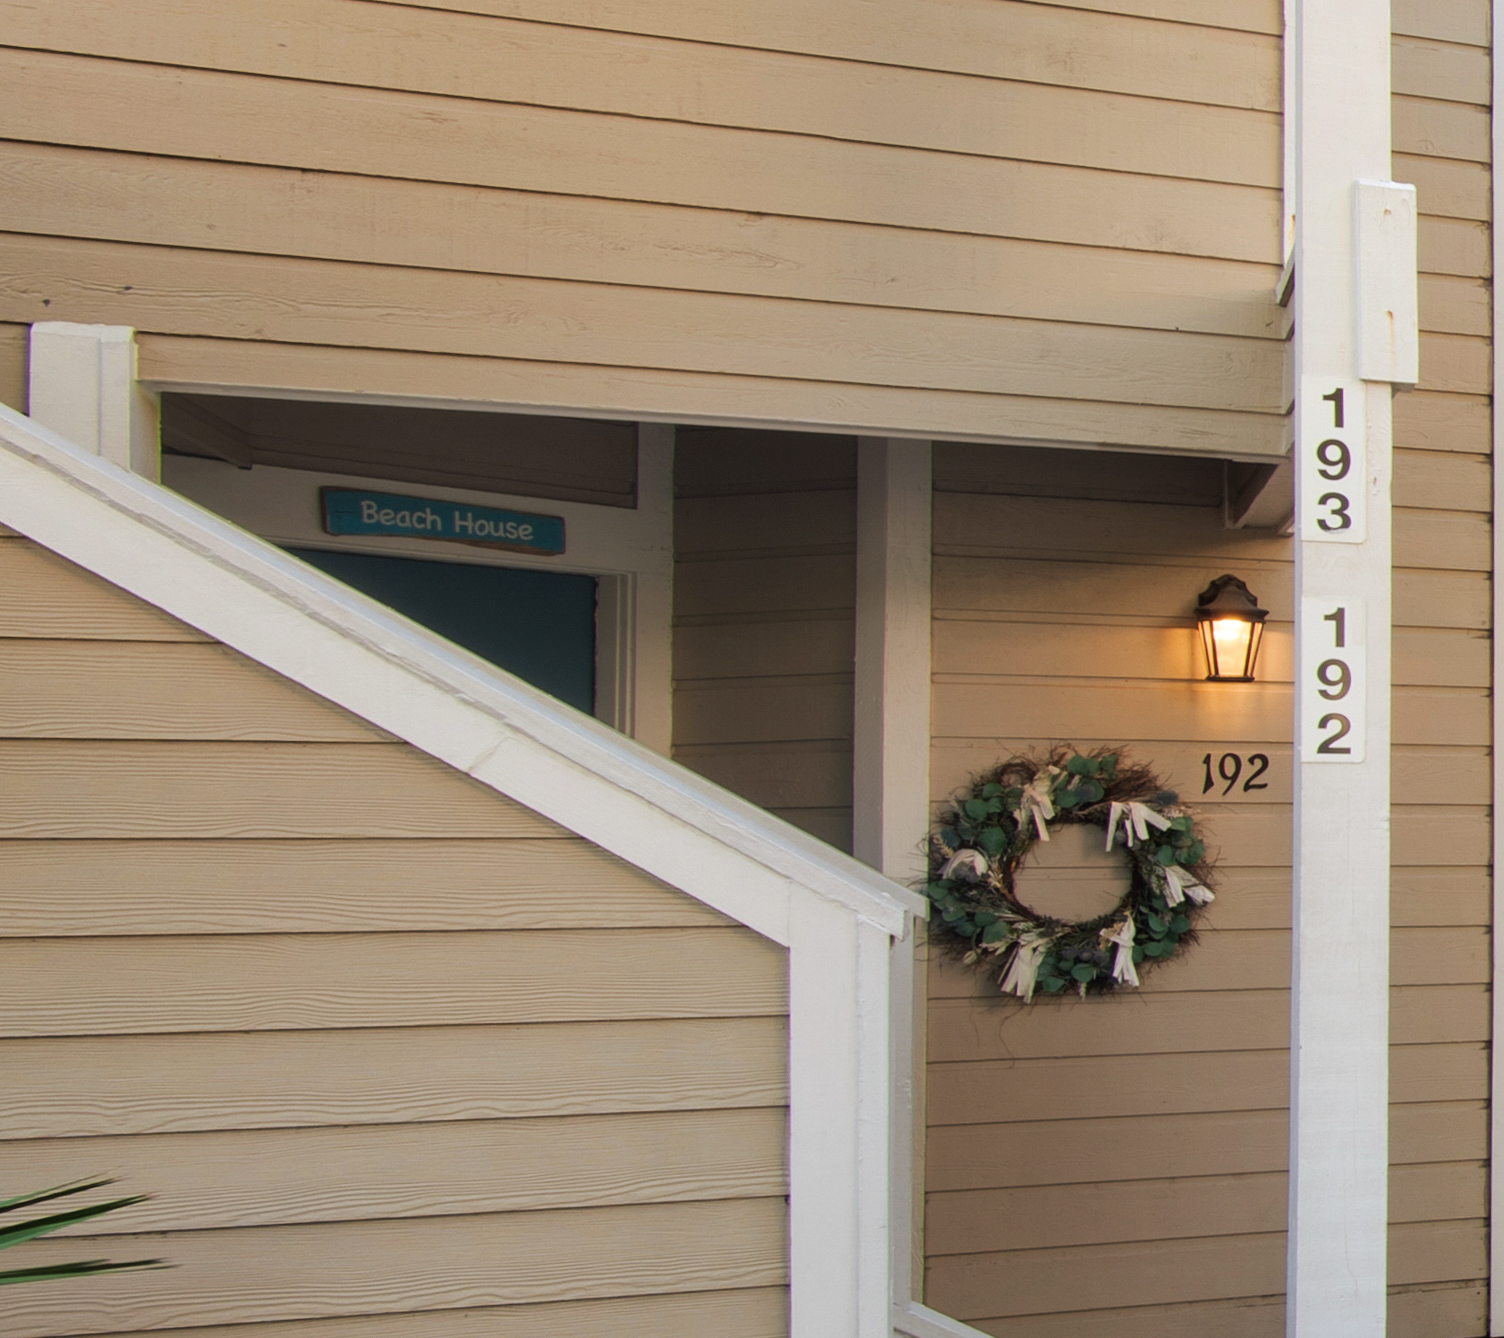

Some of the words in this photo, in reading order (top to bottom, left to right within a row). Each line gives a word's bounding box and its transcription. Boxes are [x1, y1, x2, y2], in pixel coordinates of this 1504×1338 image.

[1316, 387, 1352, 533] 193
[360, 501, 442, 532] Beach
[454, 512, 533, 541] House
[1316, 607, 1352, 754] 192
[1202, 753, 1270, 796] 192
